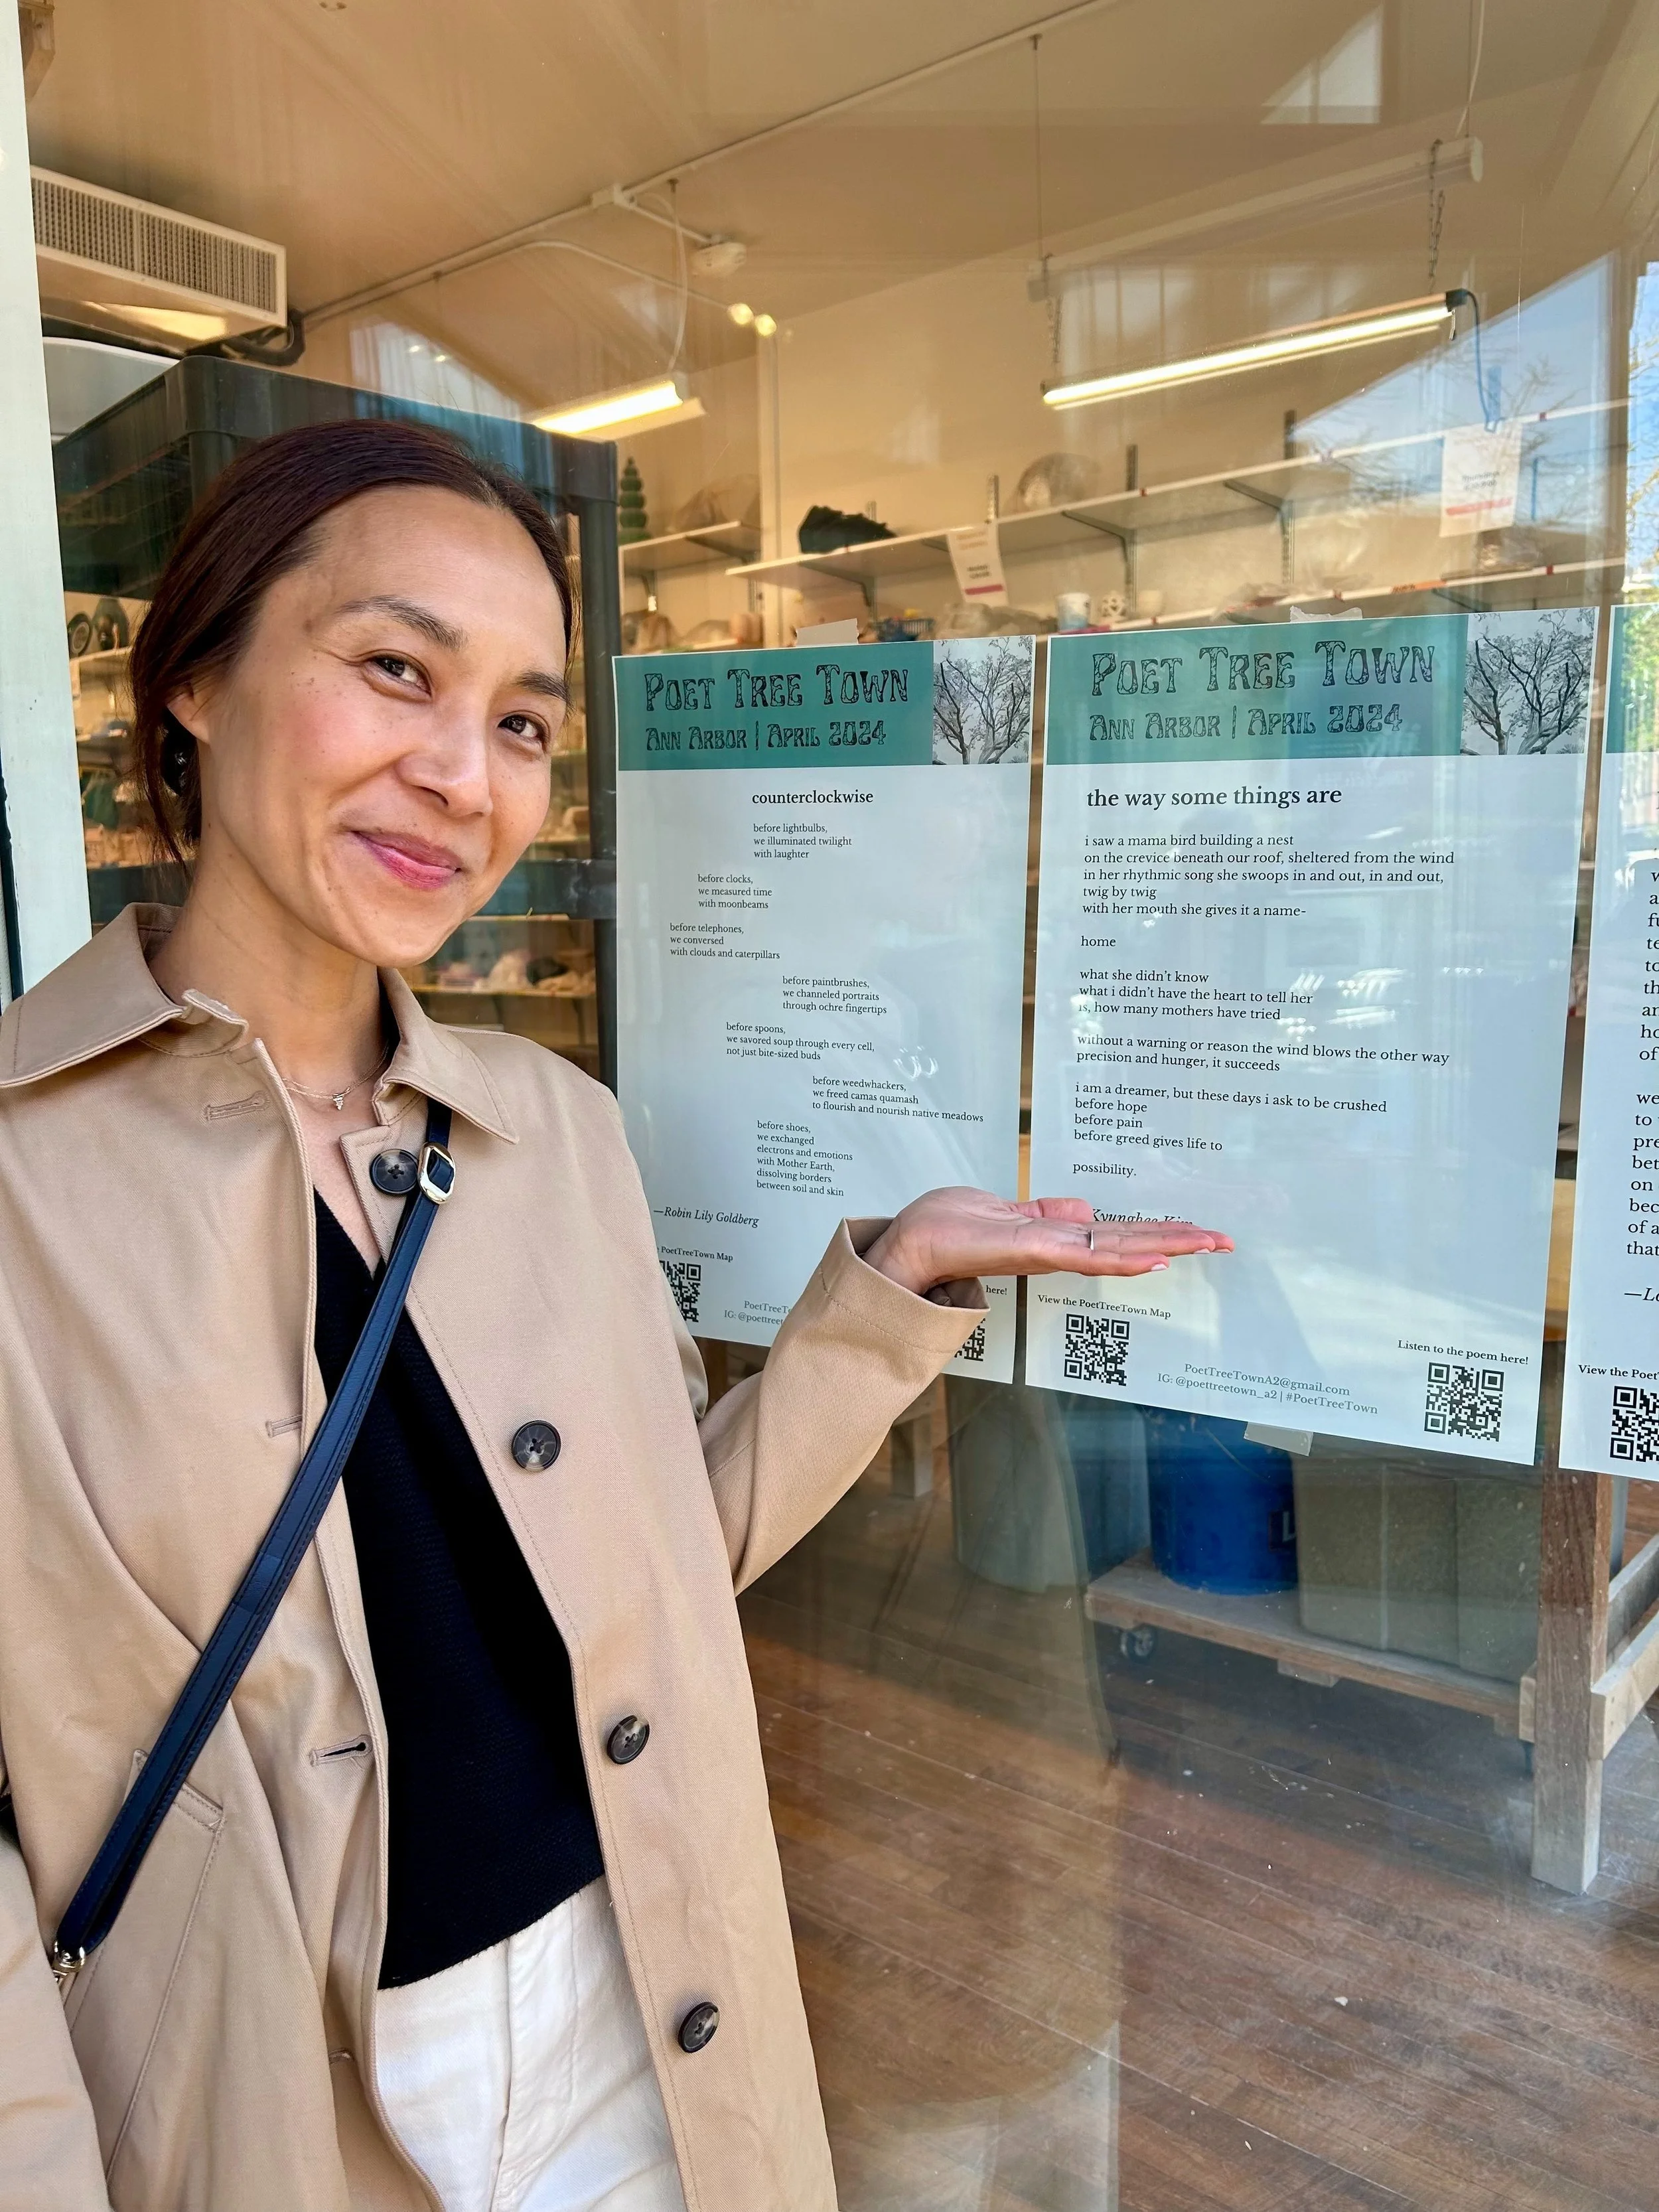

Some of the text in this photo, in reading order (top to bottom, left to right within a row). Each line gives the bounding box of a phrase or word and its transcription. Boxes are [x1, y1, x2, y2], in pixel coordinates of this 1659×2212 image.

[1327, 703, 1403, 733] 2024
[829, 720, 887, 746] 2024
[753, 789, 873, 804] counterclockwise
[1087, 786, 1342, 810] the way some things are
[754, 823, 828, 835] before lightbulbs,
[767, 836, 852, 848] illuminated twilight
[1171, 834, 1196, 846] bird
[1200, 834, 1254, 849] building
[1267, 836, 1294, 845] nest
[754, 849, 810, 860] with laughter
[1104, 852, 1123, 863] the
[1127, 852, 1170, 863] crevice
[1174, 851, 1224, 863] beneath
[1254, 851, 1284, 865] roof,
[1289, 851, 1350, 863] sheltered
[1354, 851, 1389, 863] from
[1394, 851, 1415, 863] the
[1419, 851, 1454, 863] wind
[697, 874, 753, 885] before clocks,
[711, 887, 751, 898] measured
[1084, 886, 1157, 900] twig twig
[699, 897, 768, 909] with moonbeams
[1082, 902, 1109, 913] with
[1112, 903, 1133, 913] her
[1136, 903, 1177, 914] mouth
[1181, 903, 1202, 915] she
[1205, 904, 1237, 918] gives
[670, 922, 744, 934] before telephones,
[684, 936, 724, 945] conversed
[1081, 936, 1116, 946] home
[670, 947, 780, 960] with clouds and caterpillars
[783, 976, 869, 988] before paintbrushes,
[1080, 969, 1209, 983] what she know
[796, 989, 879, 1001] channeled portraits
[1094, 1001, 1280, 1019] how many mothers have tried
[727, 1022, 786, 1035] before spoons,
[740, 1036, 874, 1052] savored soup through every cell,
[1078, 1035, 1449, 1066] without warning reason the wind blows the other way
[1077, 1051, 1279, 1071] precision and hunger, succeeds
[813, 1076, 906, 1092] before weedwhackers,
[826, 1089, 849, 1099] freed
[879, 1095, 918, 1104] quamash
[1115, 1084, 1387, 1112] dreamer, but these days ask crushed
[823, 1101, 856, 1112] flourish
[858, 1104, 874, 1113] and
[877, 1106, 910, 1116] nourish
[942, 1112, 983, 1122] meadows
[1075, 1098, 1147, 1114] before hope
[757, 1120, 811, 1134] before shoes,
[1074, 1114, 1143, 1130] before pain
[1635, 1114, 1652, 1126] to
[1074, 1129, 1206, 1149] before greed gives life
[757, 1157, 835, 1172] with Mother Earth,
[1073, 1163, 1136, 1178] possibility.
[757, 1168, 831, 1183] dissolving borders
[1631, 1181, 1653, 1191] on
[694, 1210, 713, 1223] Lily
[716, 1213, 759, 1228] Goldberg
[1628, 1220, 1648, 1233] of
[661, 1246, 733, 1262] PoetTreeTown Map
[986, 1285, 1007, 1295] here!
[1038, 1295, 1171, 1319] View the PoetTreeTown Map
[1398, 1340, 1430, 1352] Listen
[1447, 1347, 1464, 1356] the
[1466, 1351, 1498, 1361] poem
[1500, 1353, 1528, 1364] here!
[1578, 1364, 1628, 1376] View the
[1185, 1364, 1350, 1396] PoetTreeTownA2@gmail.com
[1158, 1373, 1378, 1414] IG: @poettreetown_a2 #PoetTreeTown
